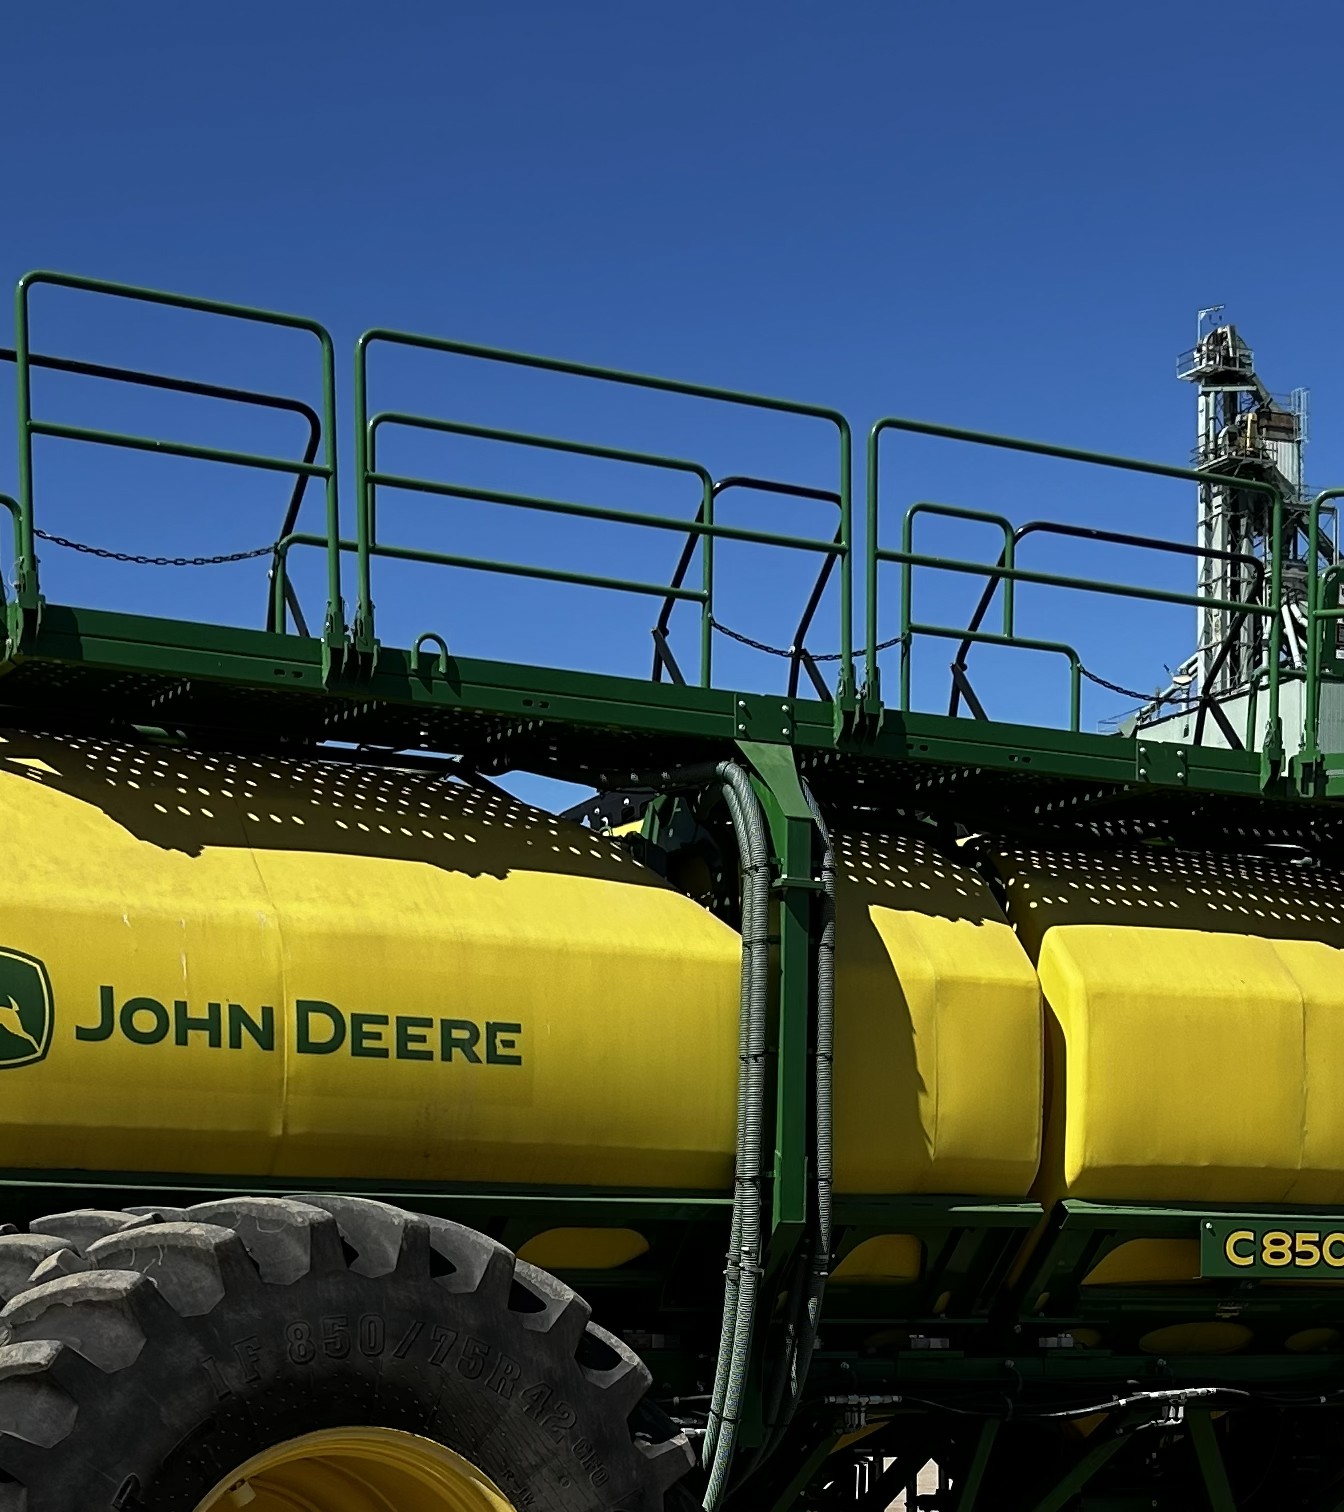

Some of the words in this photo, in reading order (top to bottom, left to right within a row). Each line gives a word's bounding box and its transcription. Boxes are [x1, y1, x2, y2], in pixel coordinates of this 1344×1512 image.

[76, 985, 274, 1052] JOHN
[295, 999, 523, 1067] DEERE
[285, 1313, 578, 1444] 850/75R42
